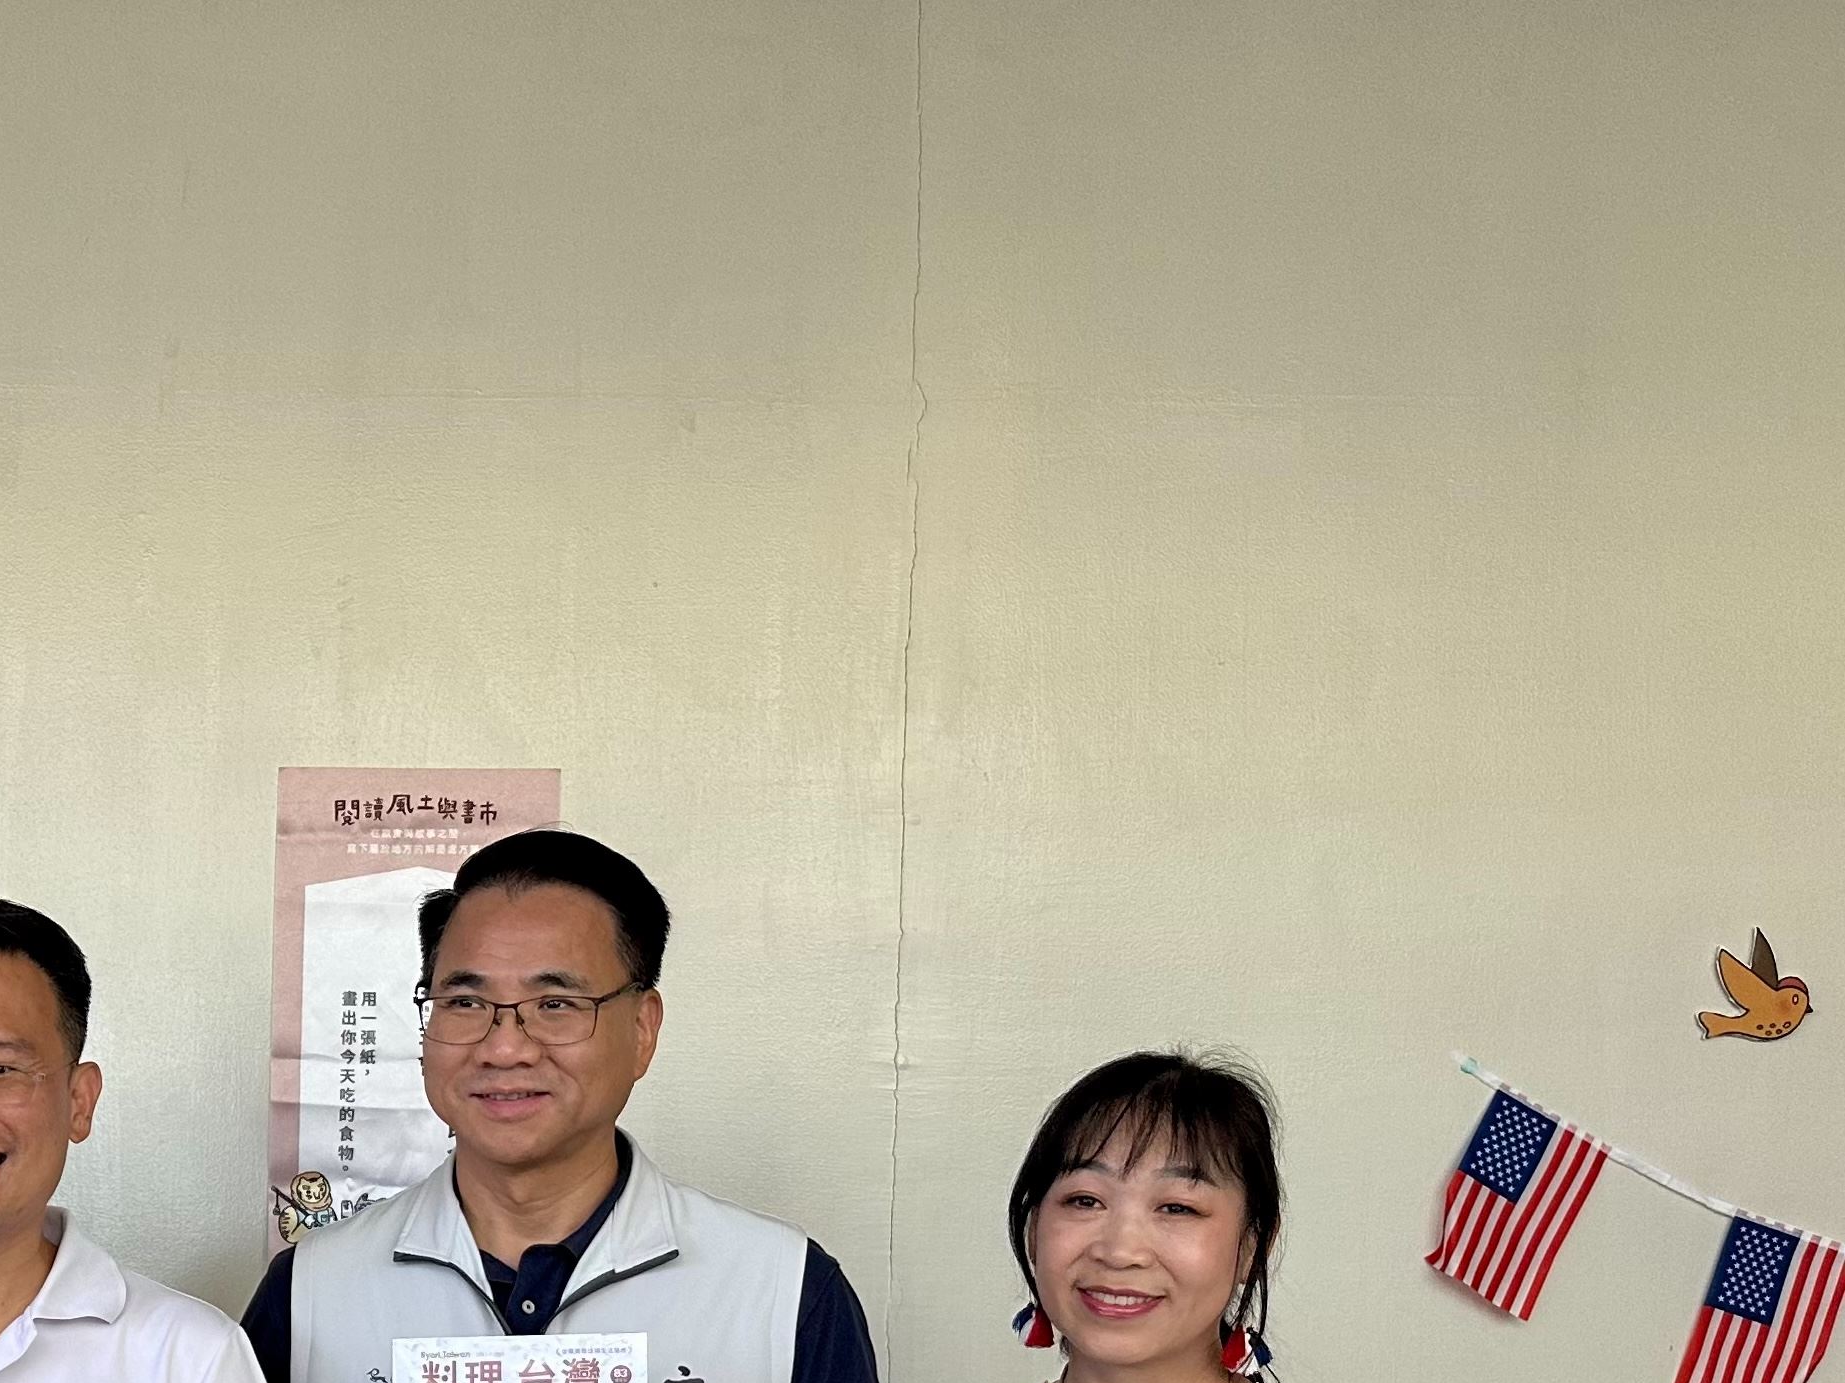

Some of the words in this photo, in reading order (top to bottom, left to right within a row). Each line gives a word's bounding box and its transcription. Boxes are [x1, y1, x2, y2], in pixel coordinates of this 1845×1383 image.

[334, 795, 497, 825] 閱讀風土與書市
[360, 992, 376, 1076] 用一張紙，
[338, 990, 358, 1171] 畫出你今天吃的食物。
